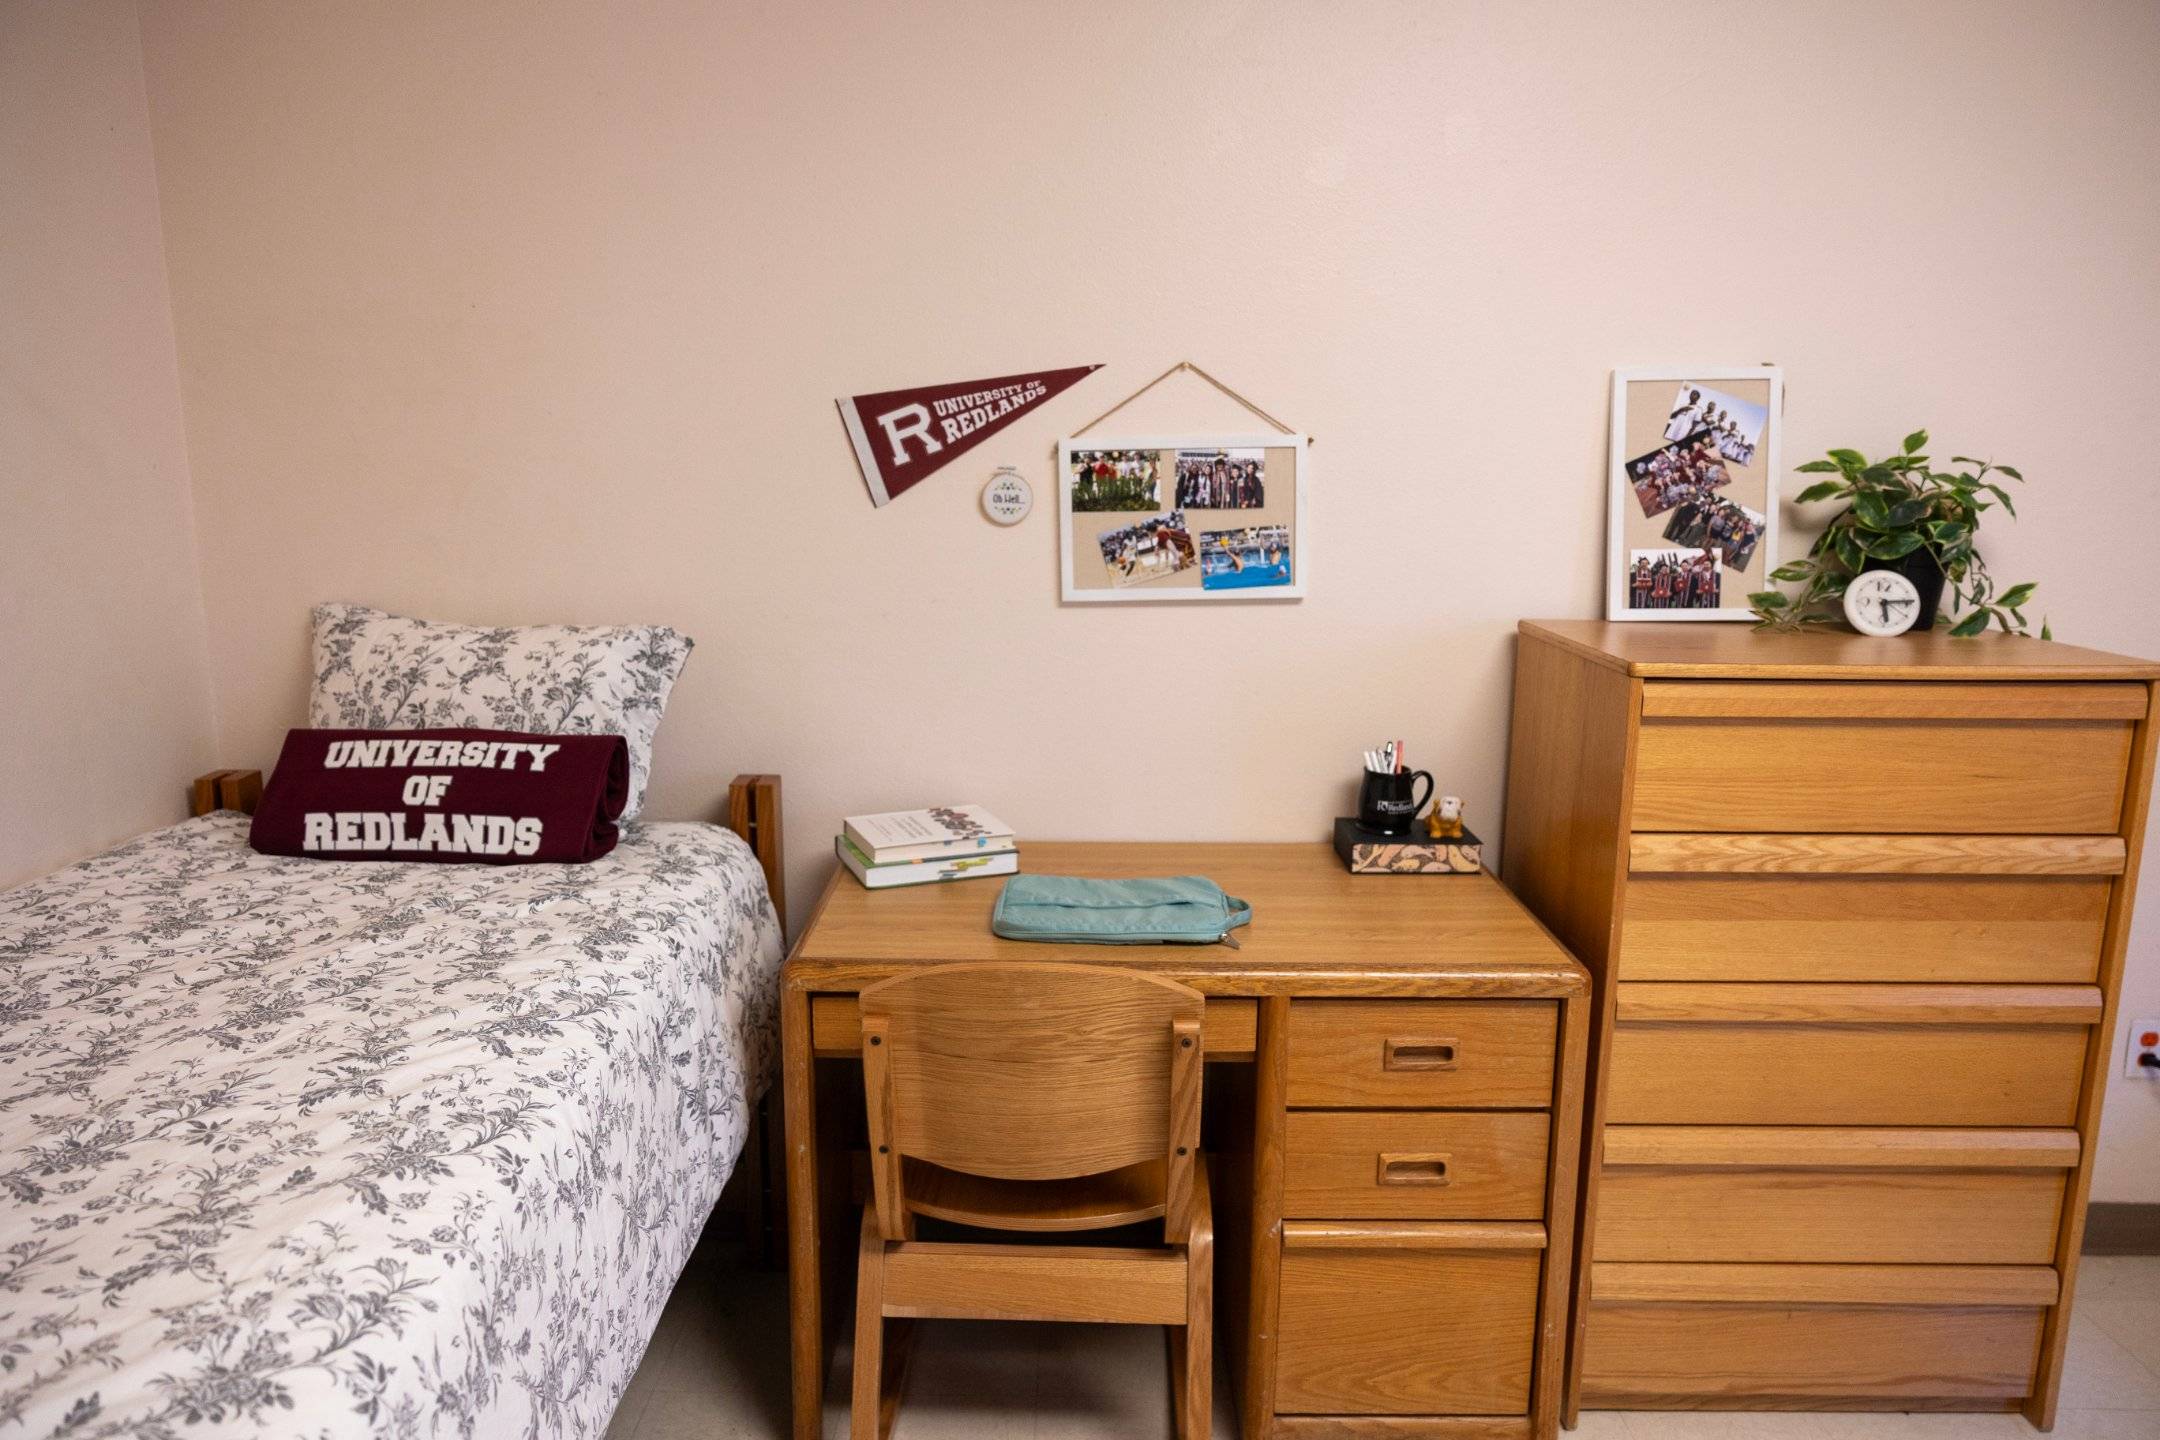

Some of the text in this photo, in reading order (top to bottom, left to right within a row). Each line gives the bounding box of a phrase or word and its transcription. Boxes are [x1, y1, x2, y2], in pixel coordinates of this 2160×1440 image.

[933, 379, 1042, 416] UNIVERSITY OF
[941, 385, 1047, 444] REDLANDS
[876, 402, 943, 466] R
[323, 739, 561, 772] UNIVERSITY
[402, 775, 453, 806] OF
[302, 812, 544, 856] REDLANDS
